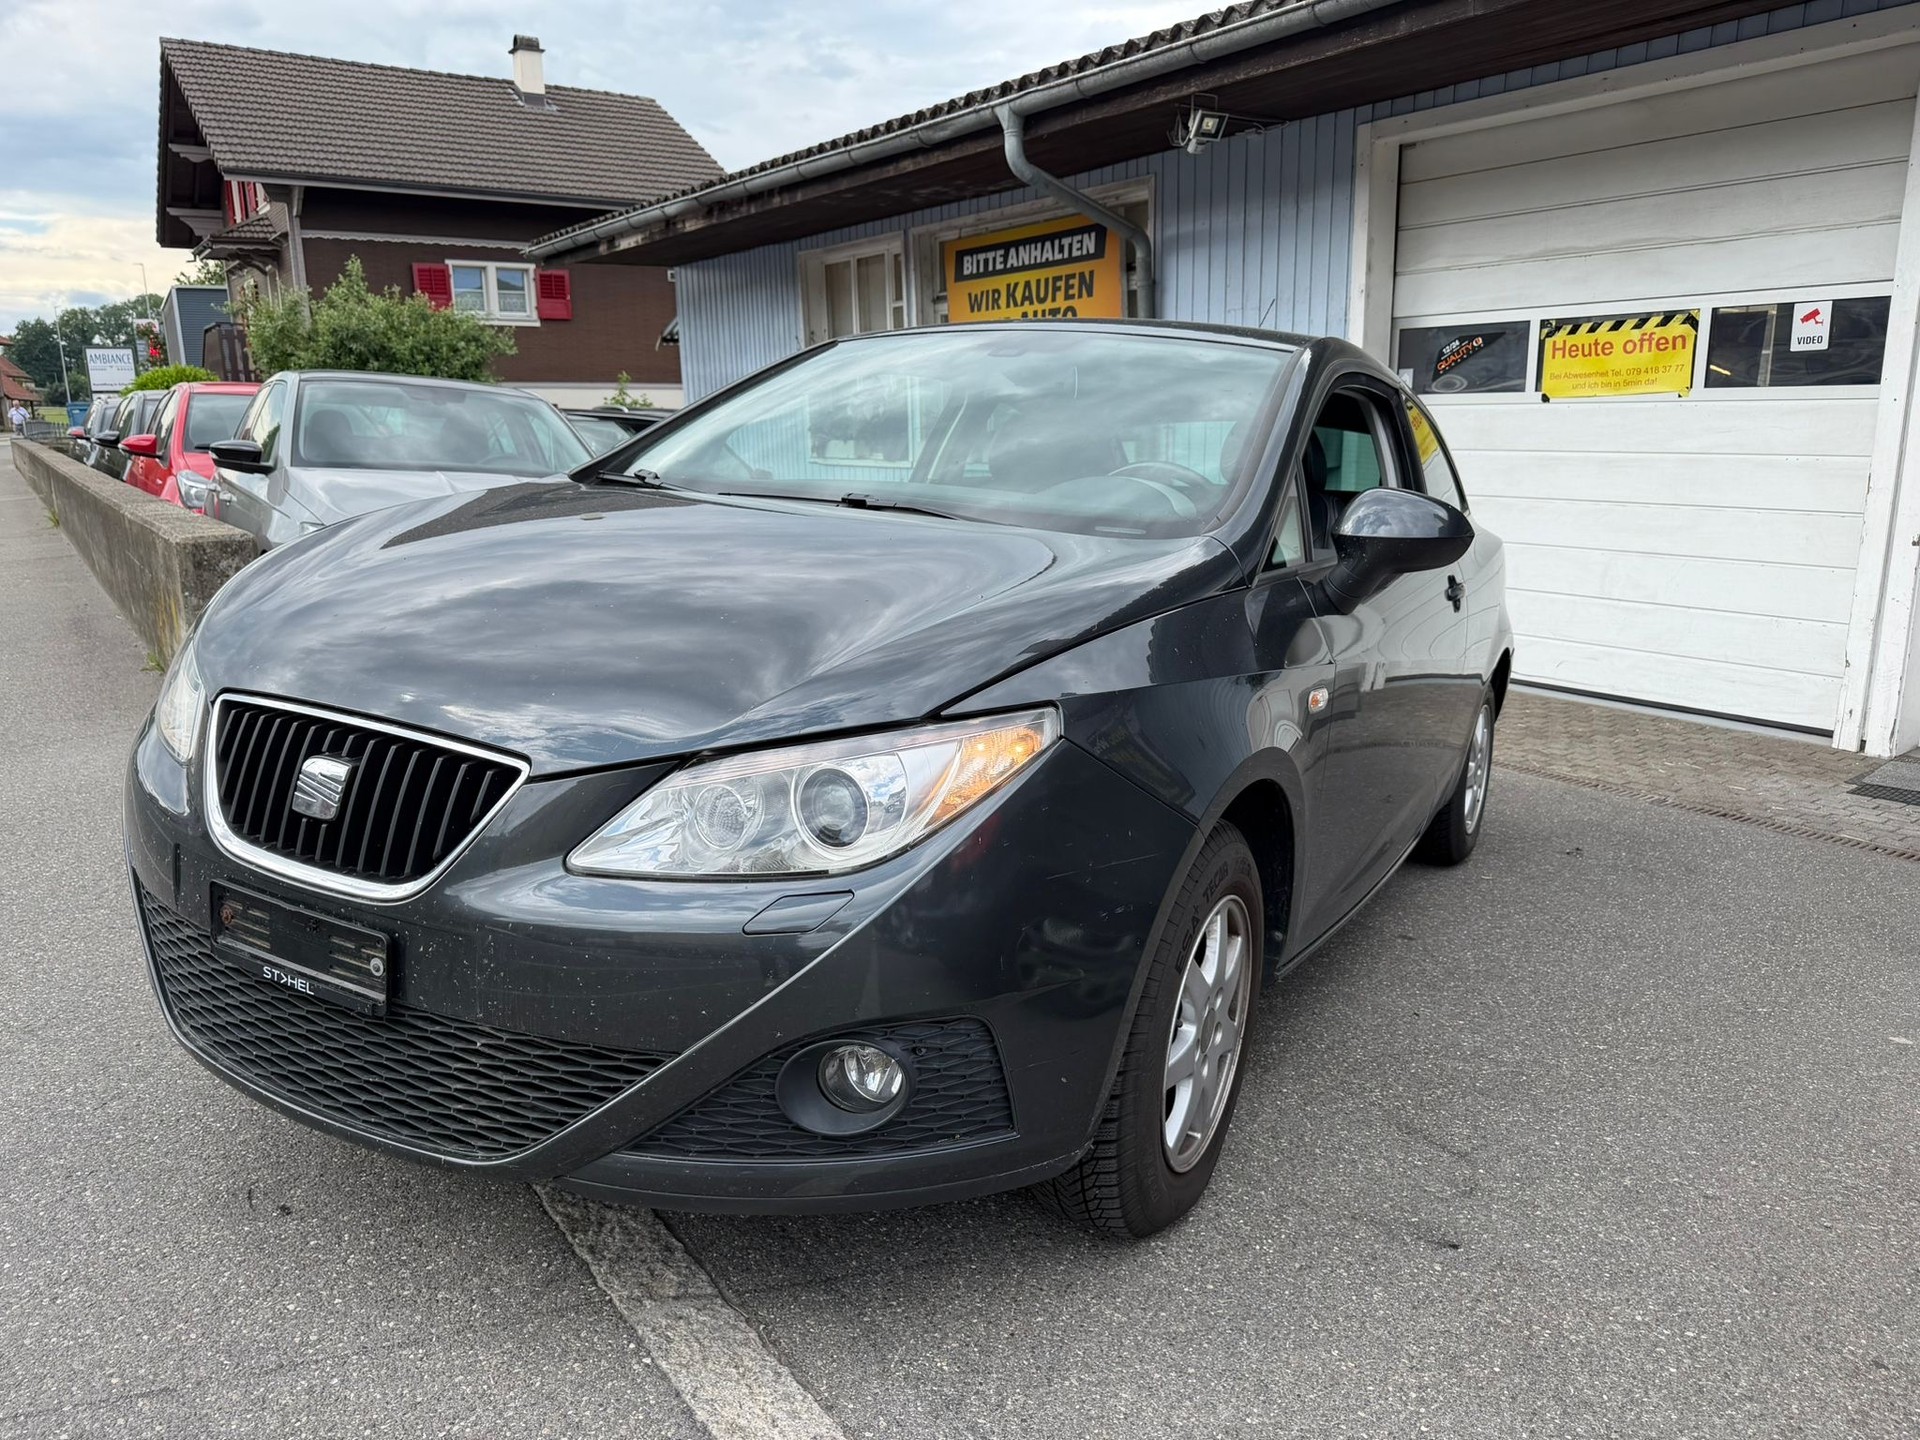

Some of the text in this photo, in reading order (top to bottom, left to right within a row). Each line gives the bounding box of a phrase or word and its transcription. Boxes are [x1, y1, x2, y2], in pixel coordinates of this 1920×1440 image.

[963, 231, 1096, 275] BITTE ANHALTEN
[968, 270, 1095, 313] WIR KAUFEN
[1551, 331, 1687, 359] Heute offen
[1797, 335, 1823, 345] VIDEO
[90, 353, 132, 365] AMBIANCE
[1549, 363, 1685, 380] Bei Abwesenheit Tel. 079 418 37 77
[1571, 380, 1586, 390] und
[1588, 379, 1600, 389] ich
[1601, 378, 1613, 388] bin
[1613, 378, 1621, 388] in
[1622, 377, 1643, 387] 5min
